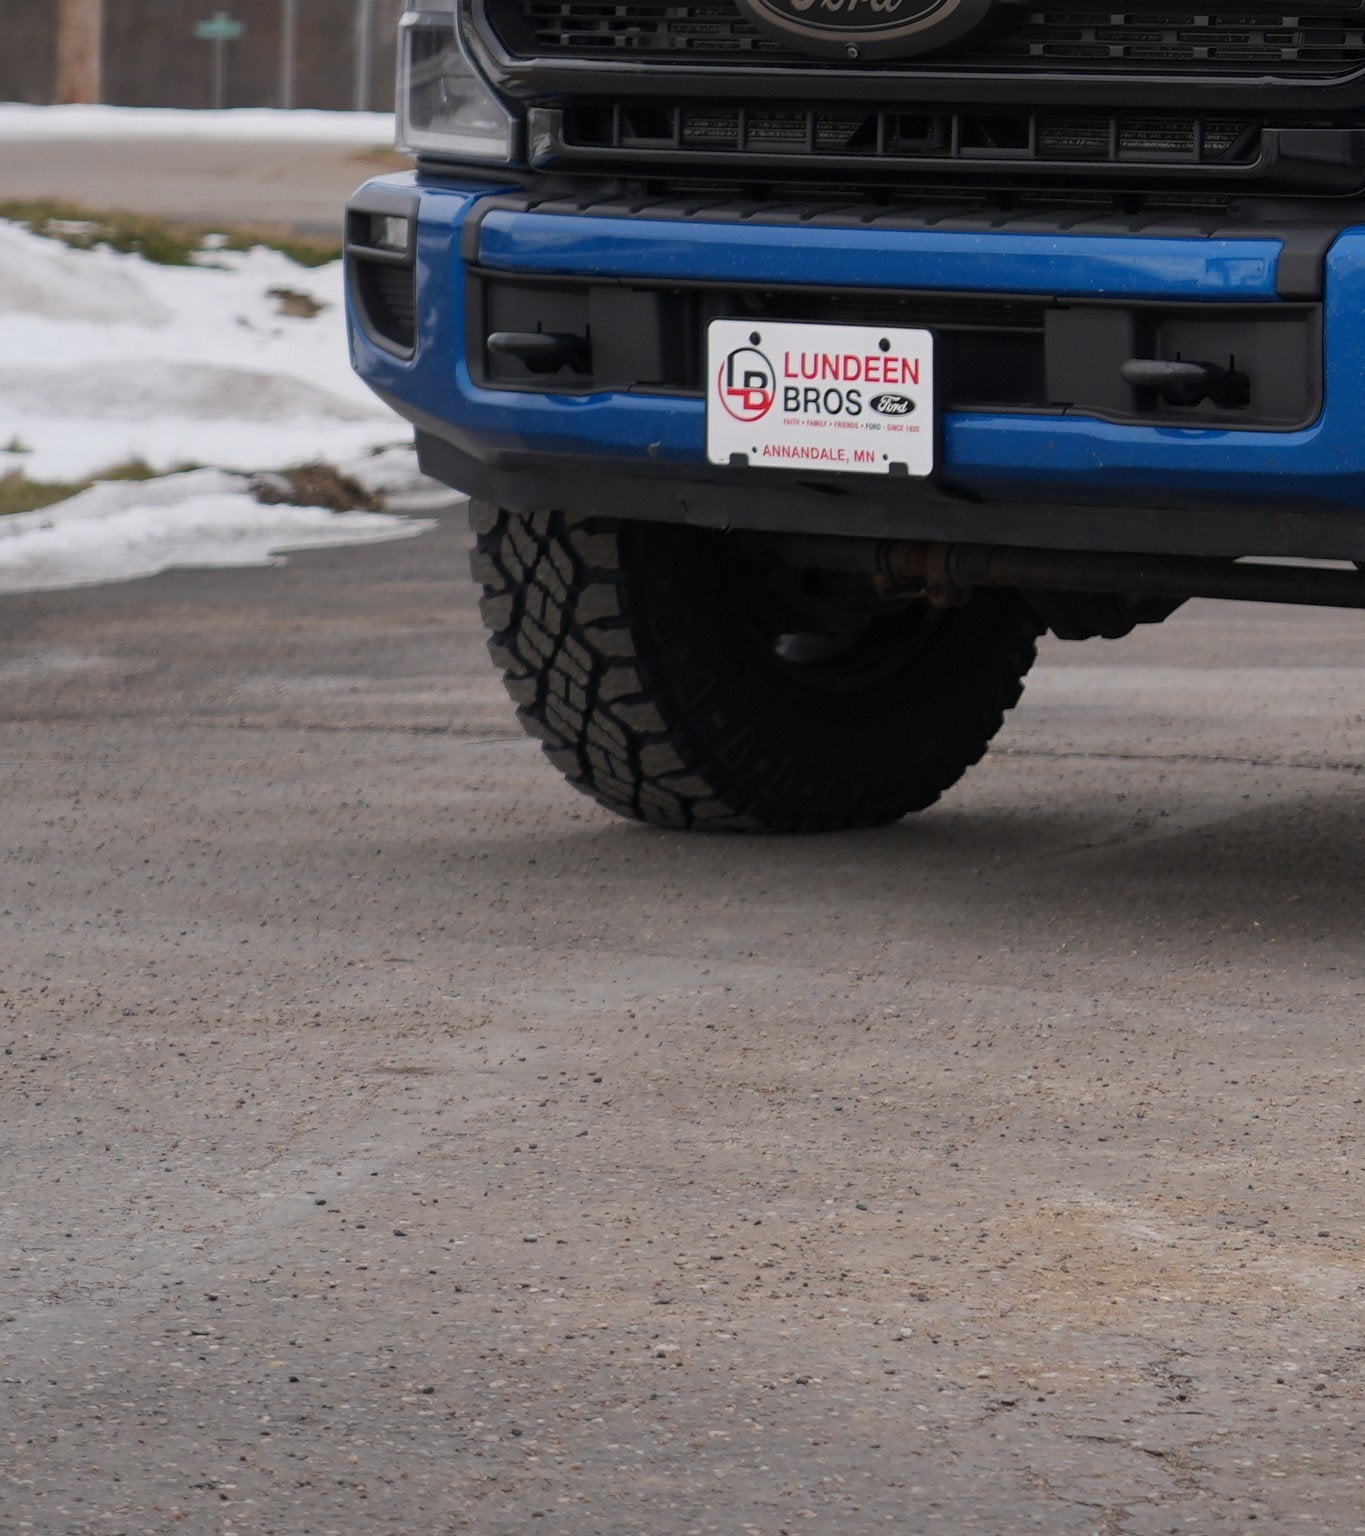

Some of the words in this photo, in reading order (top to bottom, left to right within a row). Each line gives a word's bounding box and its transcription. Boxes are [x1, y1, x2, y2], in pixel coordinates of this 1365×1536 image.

[783, 351, 920, 385] LUNDEEN
[783, 386, 863, 416] BROS
[783, 418, 800, 426] FAITH
[806, 419, 828, 427] FAMILY
[834, 421, 859, 429] FRIENDS
[865, 423, 881, 431] FORD
[886, 424, 904, 432] SINCE
[762, 444, 850, 464] ANNANDALE,
[854, 450, 876, 463] MN
